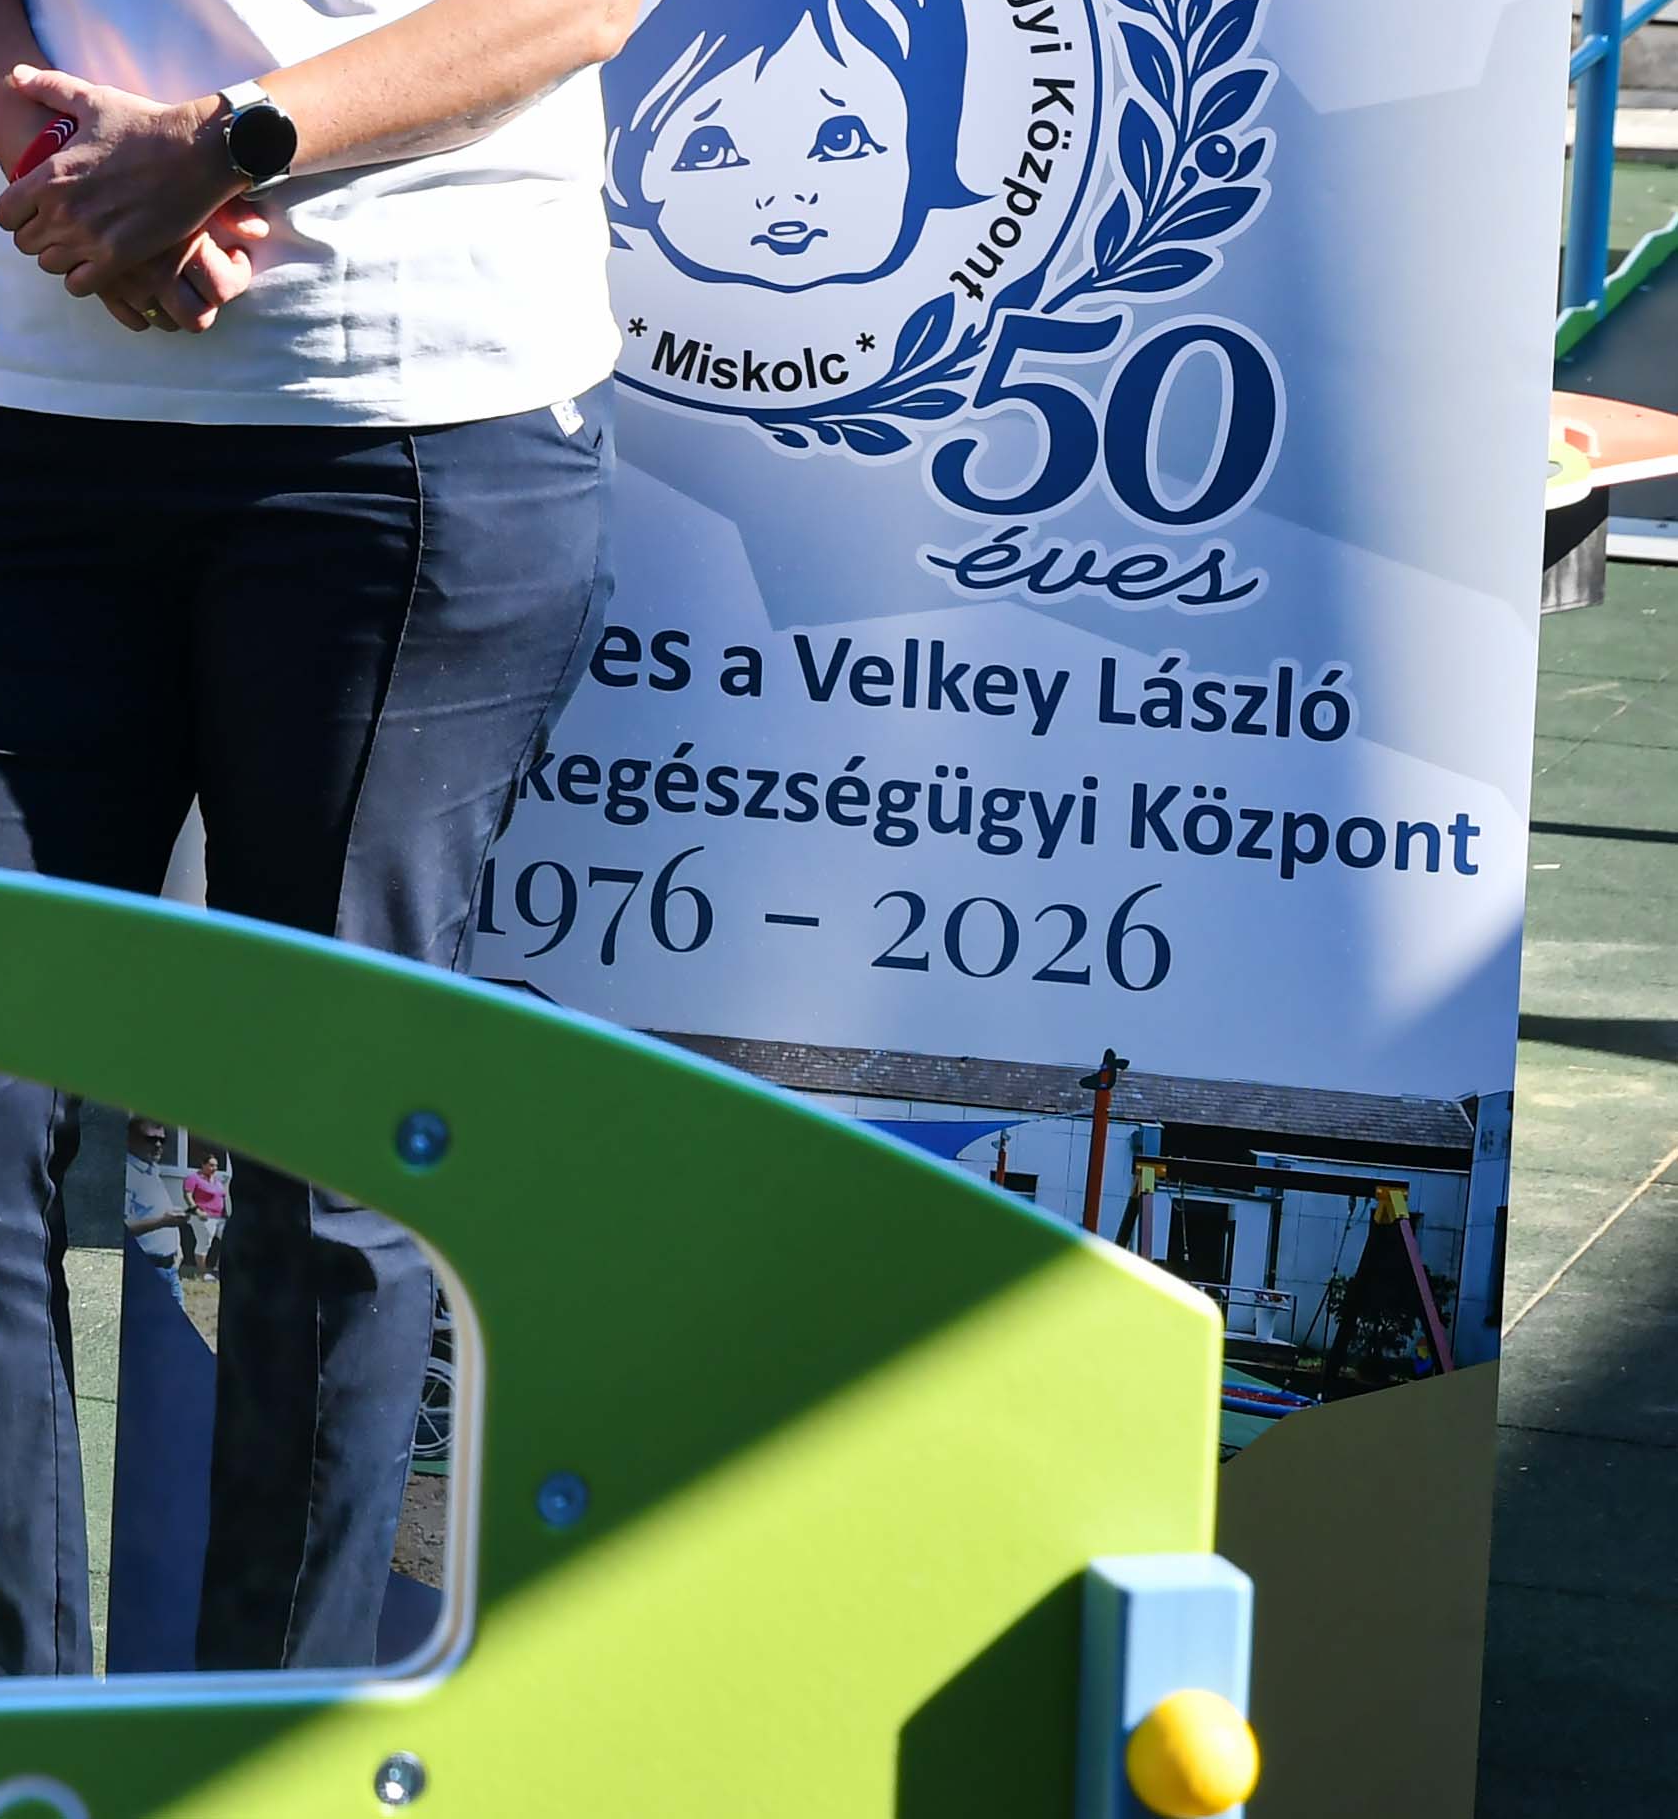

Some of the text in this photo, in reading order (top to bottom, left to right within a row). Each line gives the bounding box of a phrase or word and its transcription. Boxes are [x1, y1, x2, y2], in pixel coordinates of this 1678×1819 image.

[949, 77, 1076, 302] Központ
[651, 330, 850, 393] Miskolc
[932, 314, 1276, 526] 50
[927, 525, 1259, 605] éves
[589, 623, 1351, 742] es a Velkey László
[519, 741, 1480, 880] kegészségügyi Központ
[477, 845, 714, 966] 1976
[871, 883, 1172, 991] 2026
